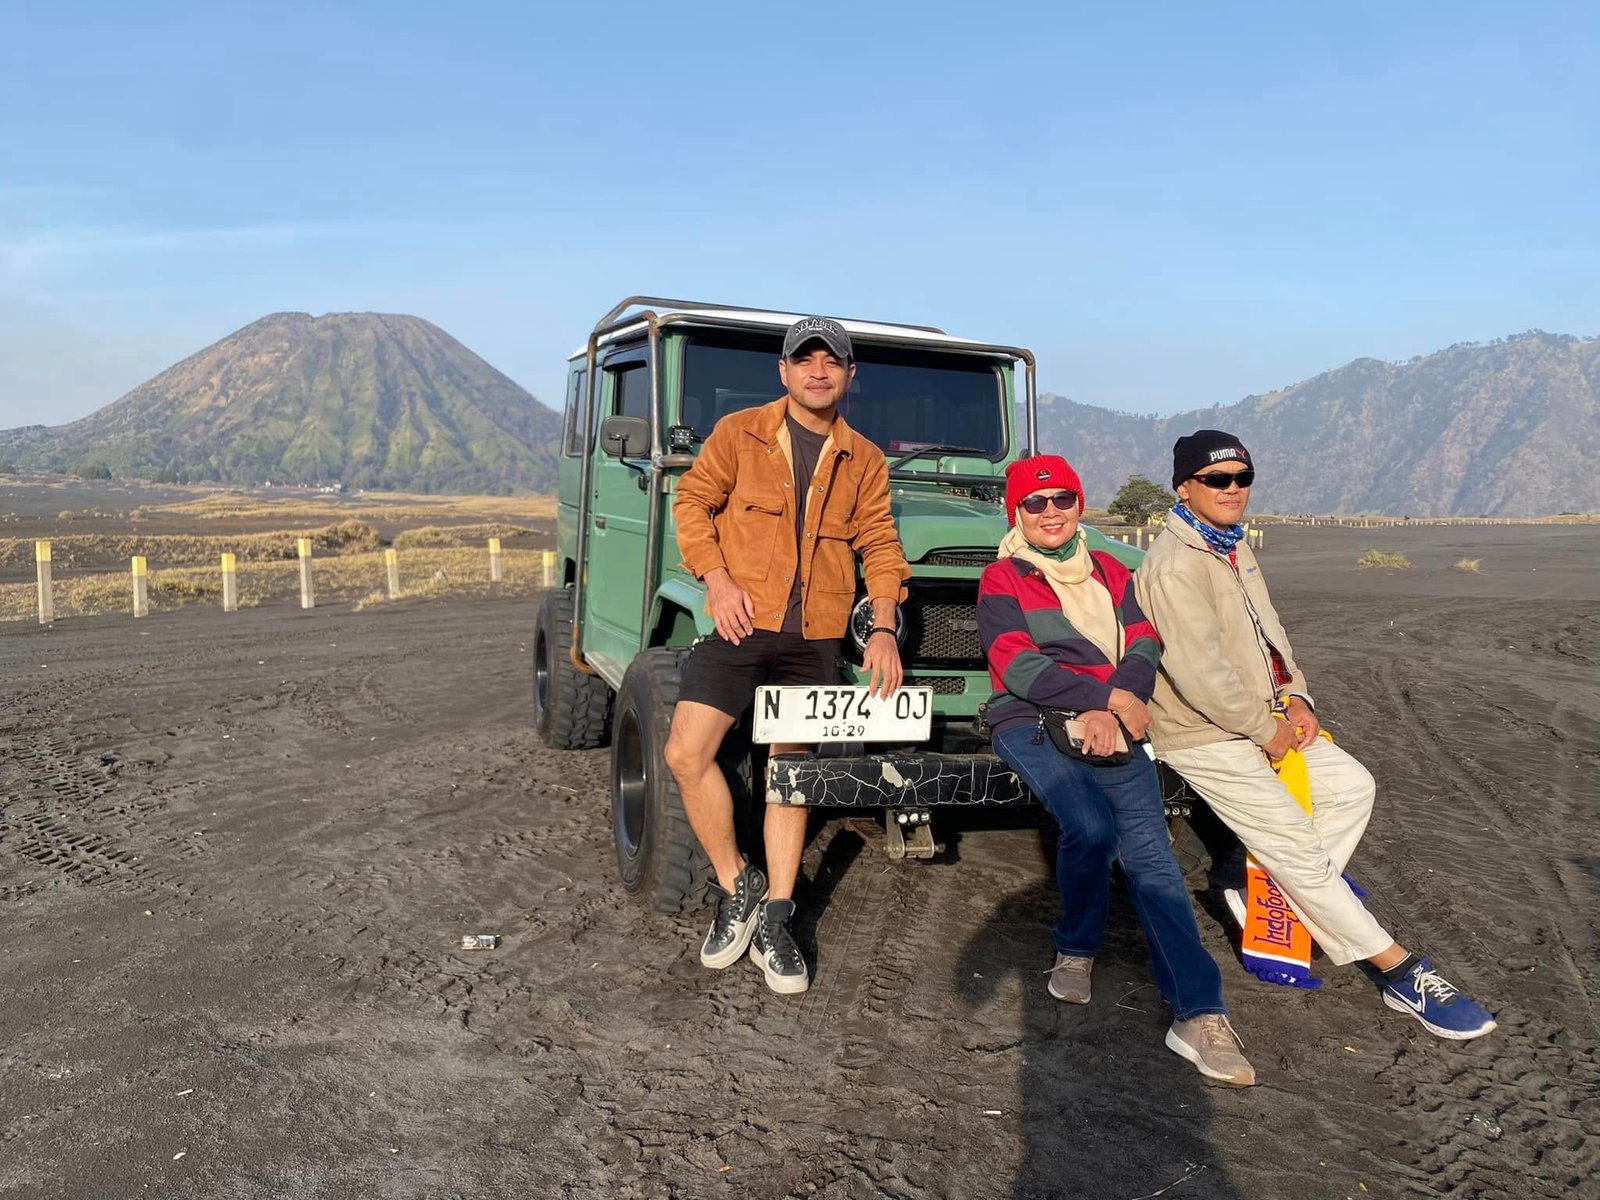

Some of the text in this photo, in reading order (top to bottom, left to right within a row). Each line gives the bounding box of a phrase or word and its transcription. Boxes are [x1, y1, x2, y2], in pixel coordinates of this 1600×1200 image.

[814, 319, 838, 336] YORK
[1210, 448, 1237, 462] PUMA
[764, 690, 928, 720] N 1374 OJ
